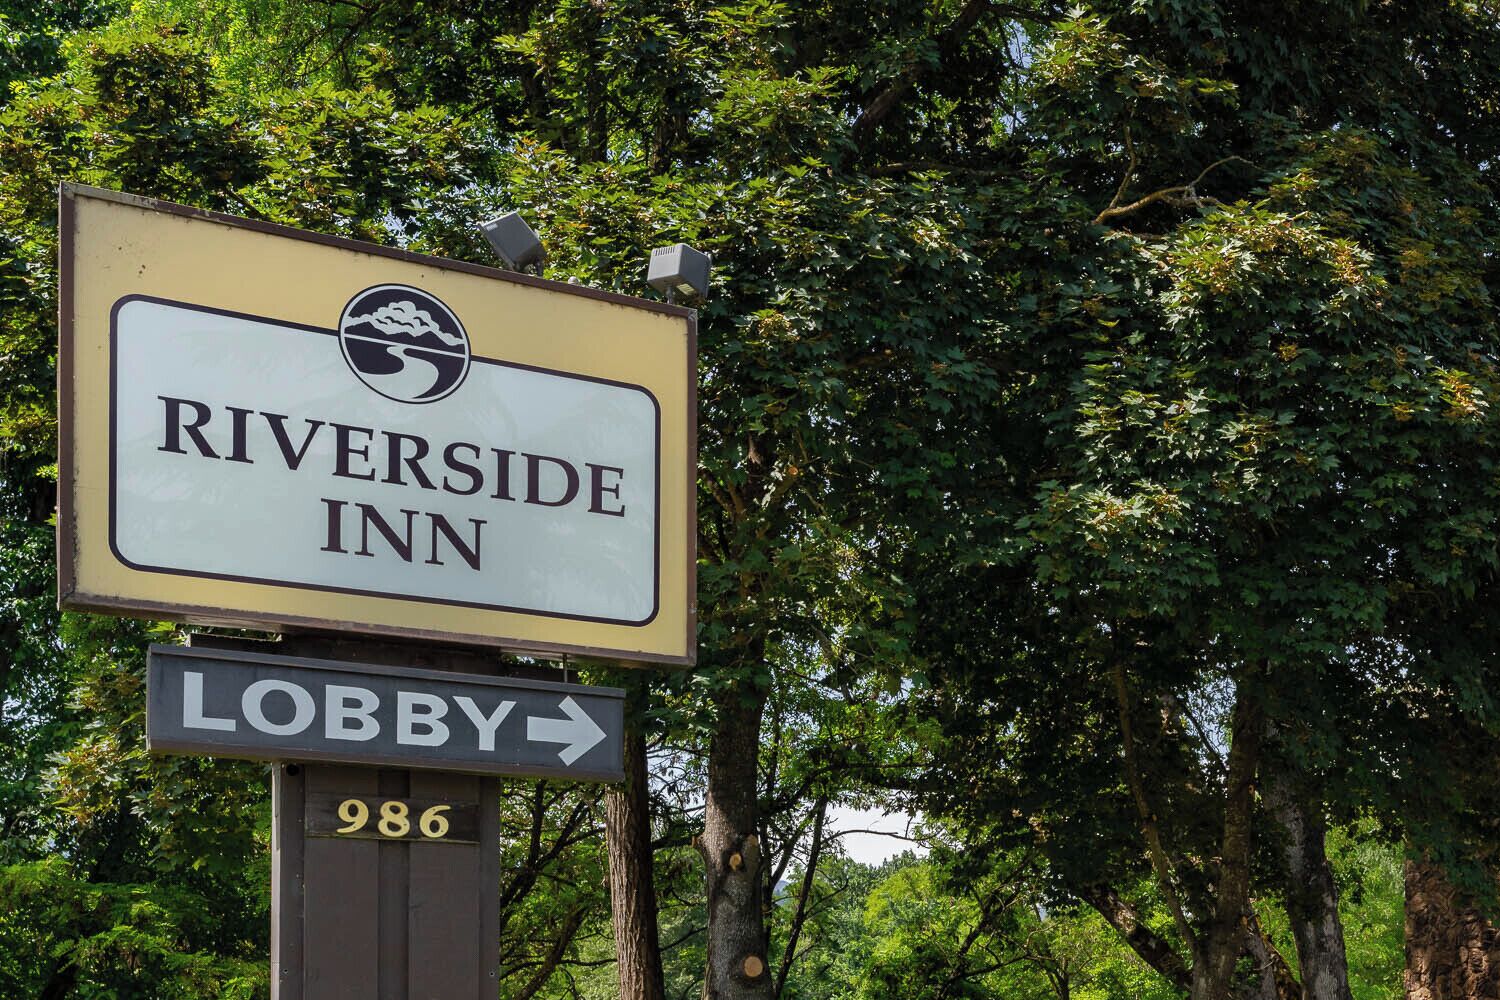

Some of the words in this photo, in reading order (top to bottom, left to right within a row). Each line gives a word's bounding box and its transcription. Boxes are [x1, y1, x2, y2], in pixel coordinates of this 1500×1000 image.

[157, 396, 626, 517] RIVERSIDE
[319, 498, 487, 571] INN
[182, 672, 517, 751] LOBBY
[336, 798, 450, 838] 986
